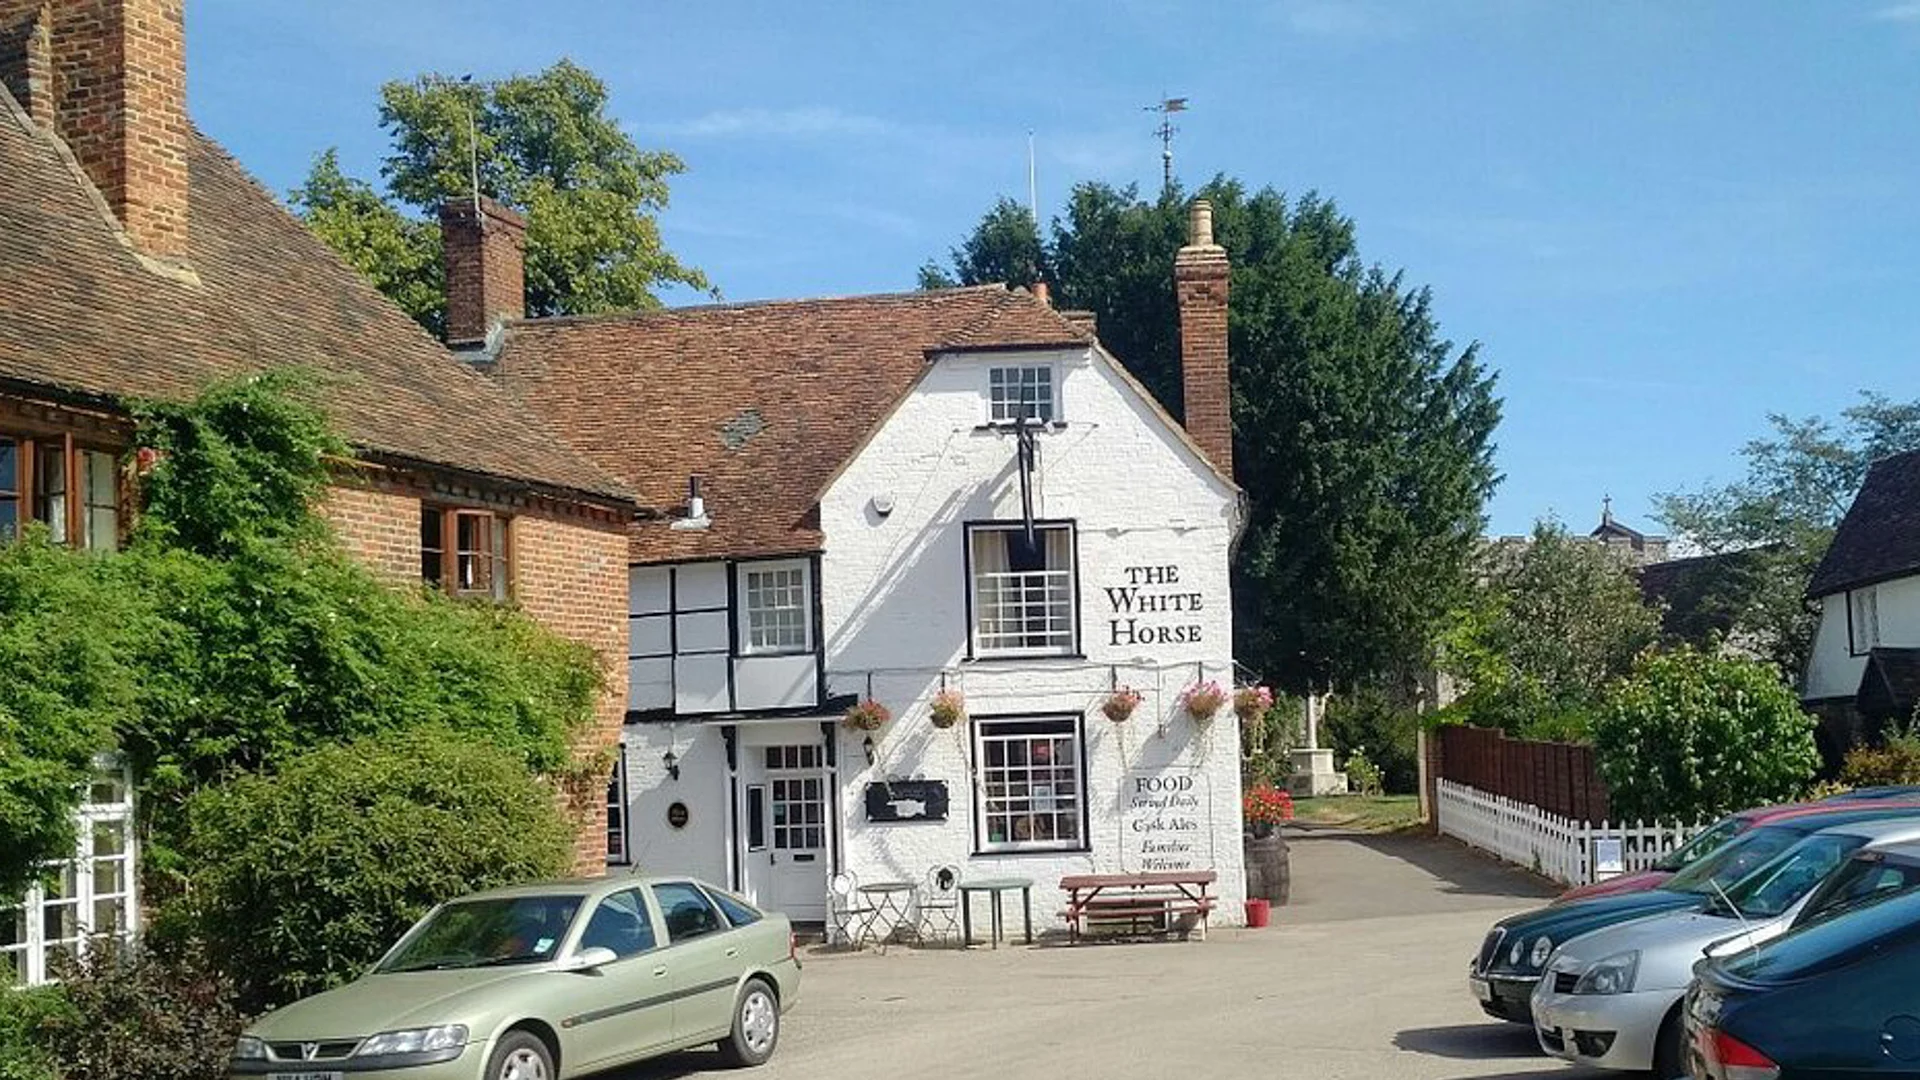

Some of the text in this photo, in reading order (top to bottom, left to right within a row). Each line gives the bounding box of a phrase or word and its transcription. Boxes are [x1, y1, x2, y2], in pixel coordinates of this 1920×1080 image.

[1124, 565, 1179, 584] THE
[1103, 587, 1203, 613] WHITE
[1108, 618, 1202, 646] HORSE
[1135, 776, 1193, 793] FOOD
